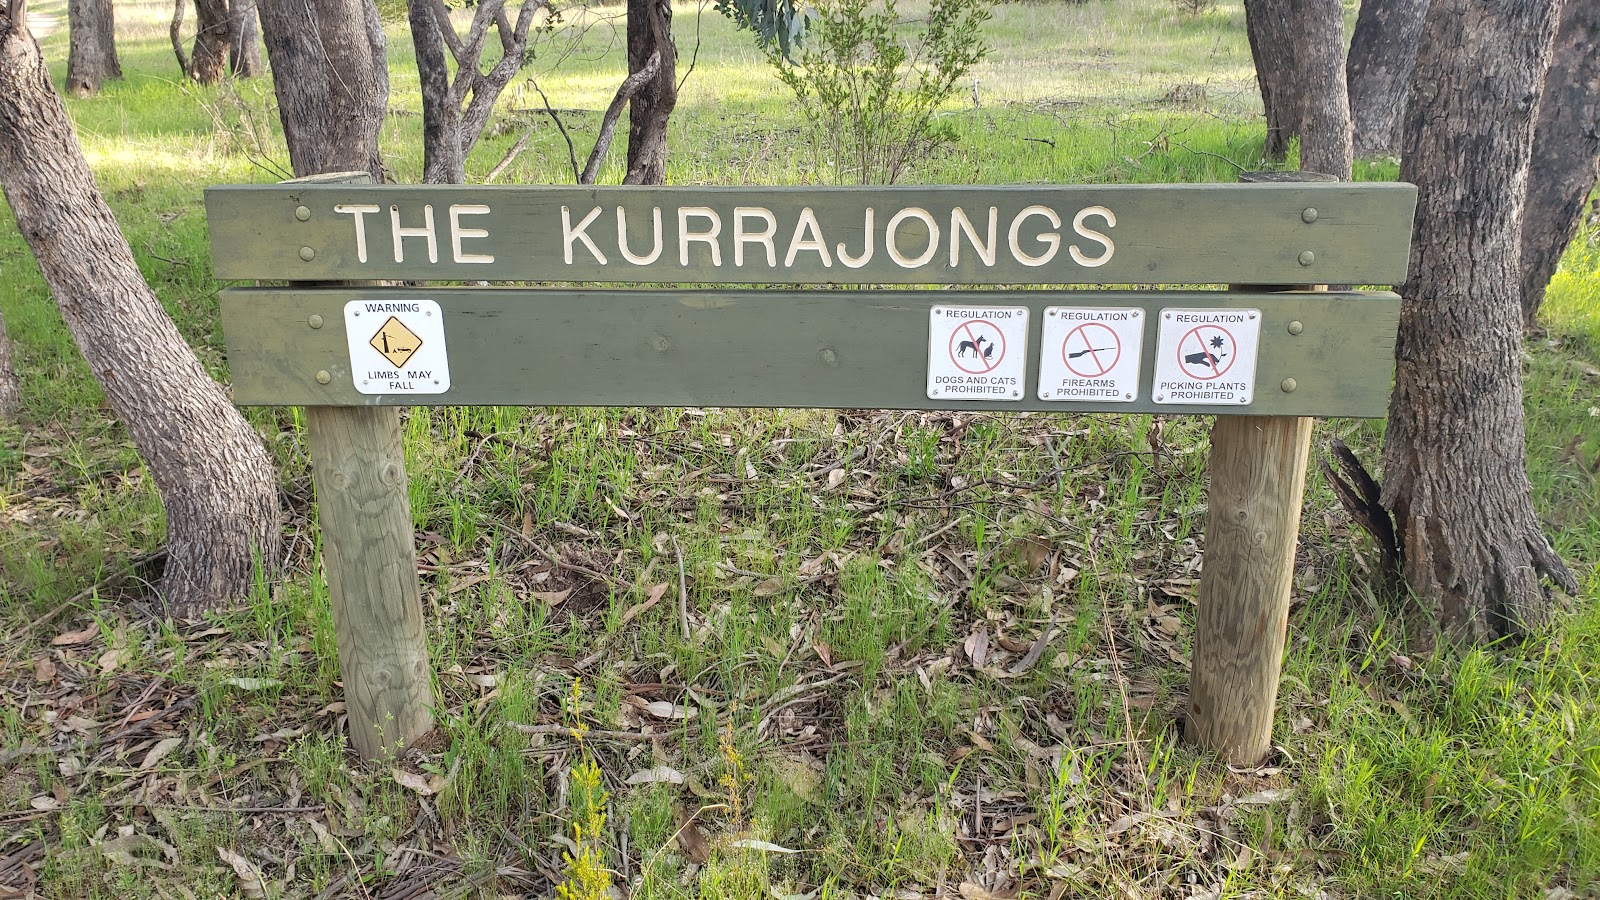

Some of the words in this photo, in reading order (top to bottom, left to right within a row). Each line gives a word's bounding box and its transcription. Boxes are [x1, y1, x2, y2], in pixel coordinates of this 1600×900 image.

[334, 203, 495, 264] THE
[560, 204, 1118, 269] KURRAJONGS
[365, 303, 420, 313] WARNING
[946, 310, 1012, 319] REGULATION
[1060, 312, 1128, 321] REGULATION
[1176, 314, 1244, 323] REGULATION
[368, 371, 399, 379] LIMBS
[408, 370, 432, 379] MAY
[935, 376, 964, 385] DOGS
[966, 376, 989, 385] AND
[990, 376, 1017, 385] CATS
[1062, 379, 1115, 388] FIREARMS
[389, 381, 414, 390] FALL
[944, 385, 1006, 394] PROHIBITED
[1160, 381, 1204, 390] PICKING
[1205, 382, 1246, 391] PLANTS
[1056, 388, 1120, 397] PROHIBITED
[1170, 391, 1234, 400] PROHIBITED
